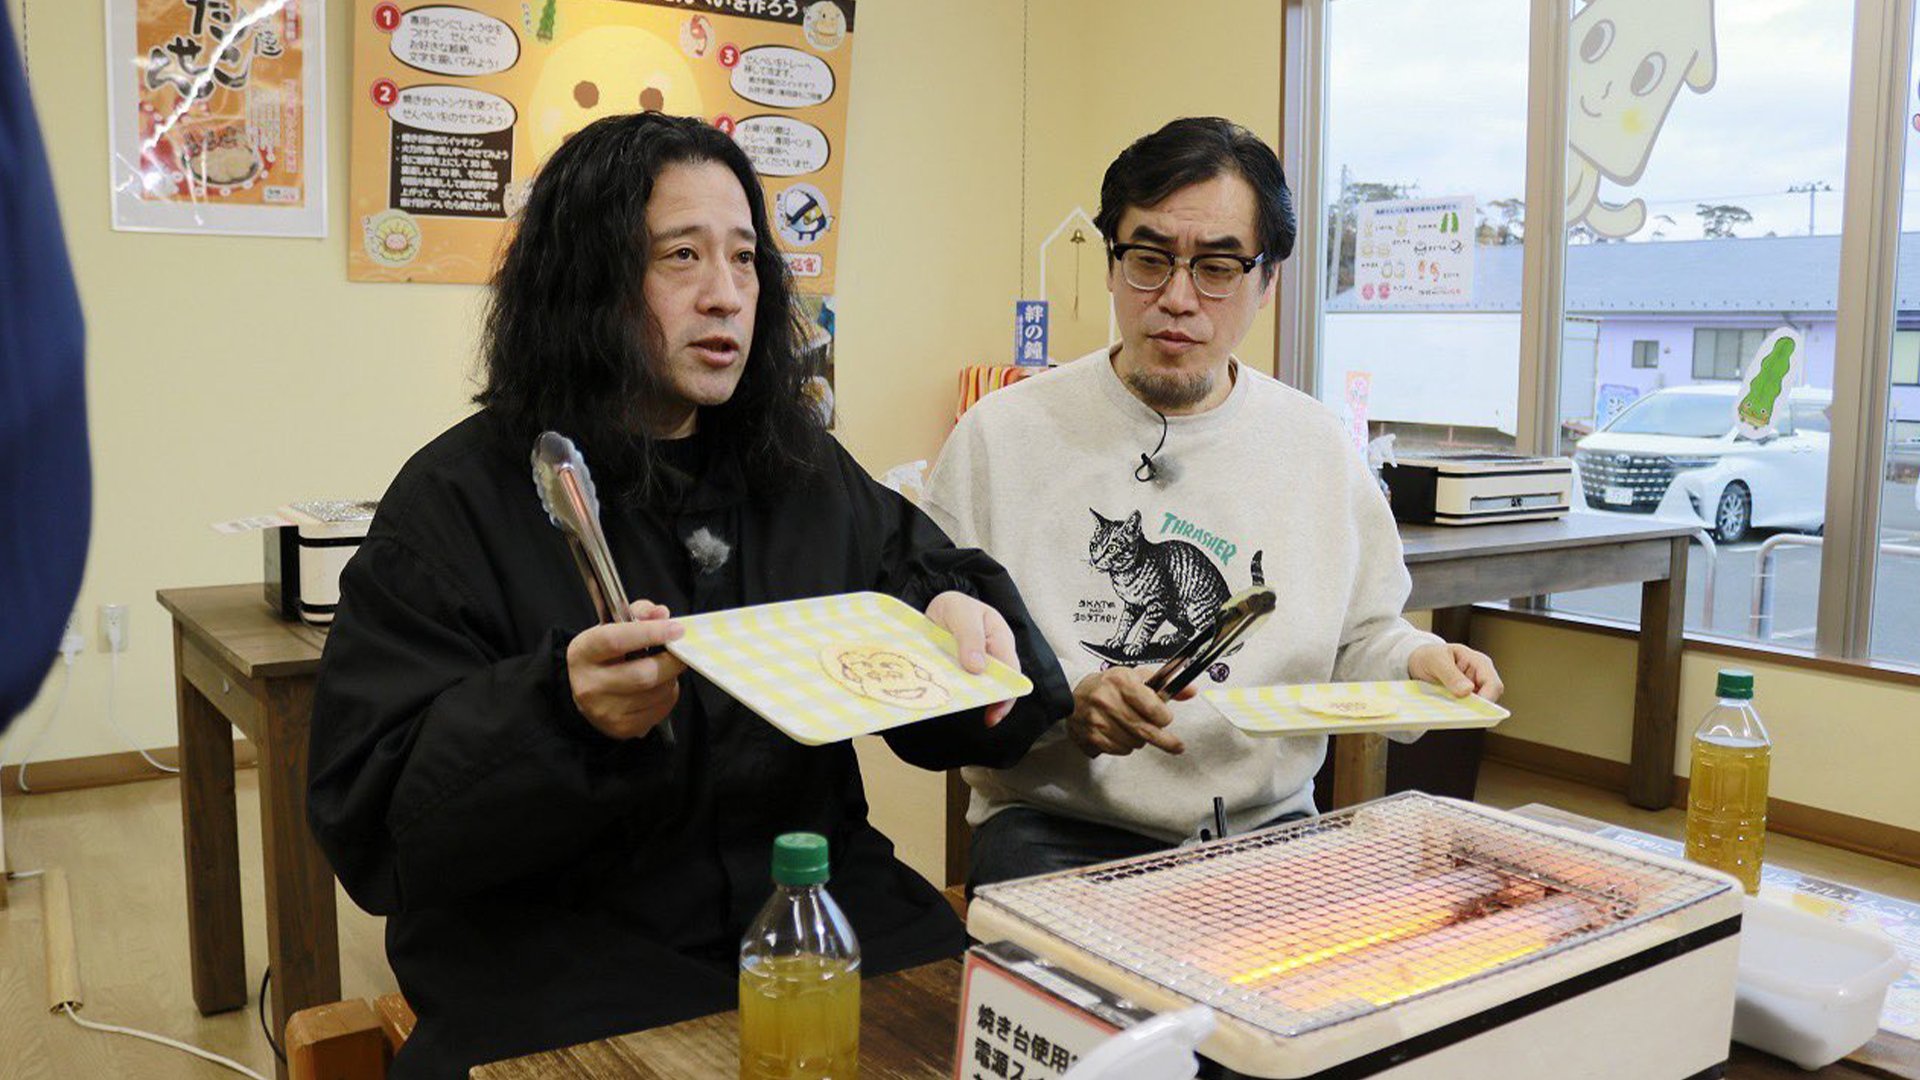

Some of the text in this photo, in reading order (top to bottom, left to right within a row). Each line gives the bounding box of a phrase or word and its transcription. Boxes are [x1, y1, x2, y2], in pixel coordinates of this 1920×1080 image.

[383, 10, 392, 26] 1
[724, 48, 734, 64] 3
[380, 86, 391, 102] 2
[1160, 512, 1237, 566] THRASHER
[978, 1003, 1079, 1075] 焼き台使用
[975, 1037, 1044, 1080] 電源ス
